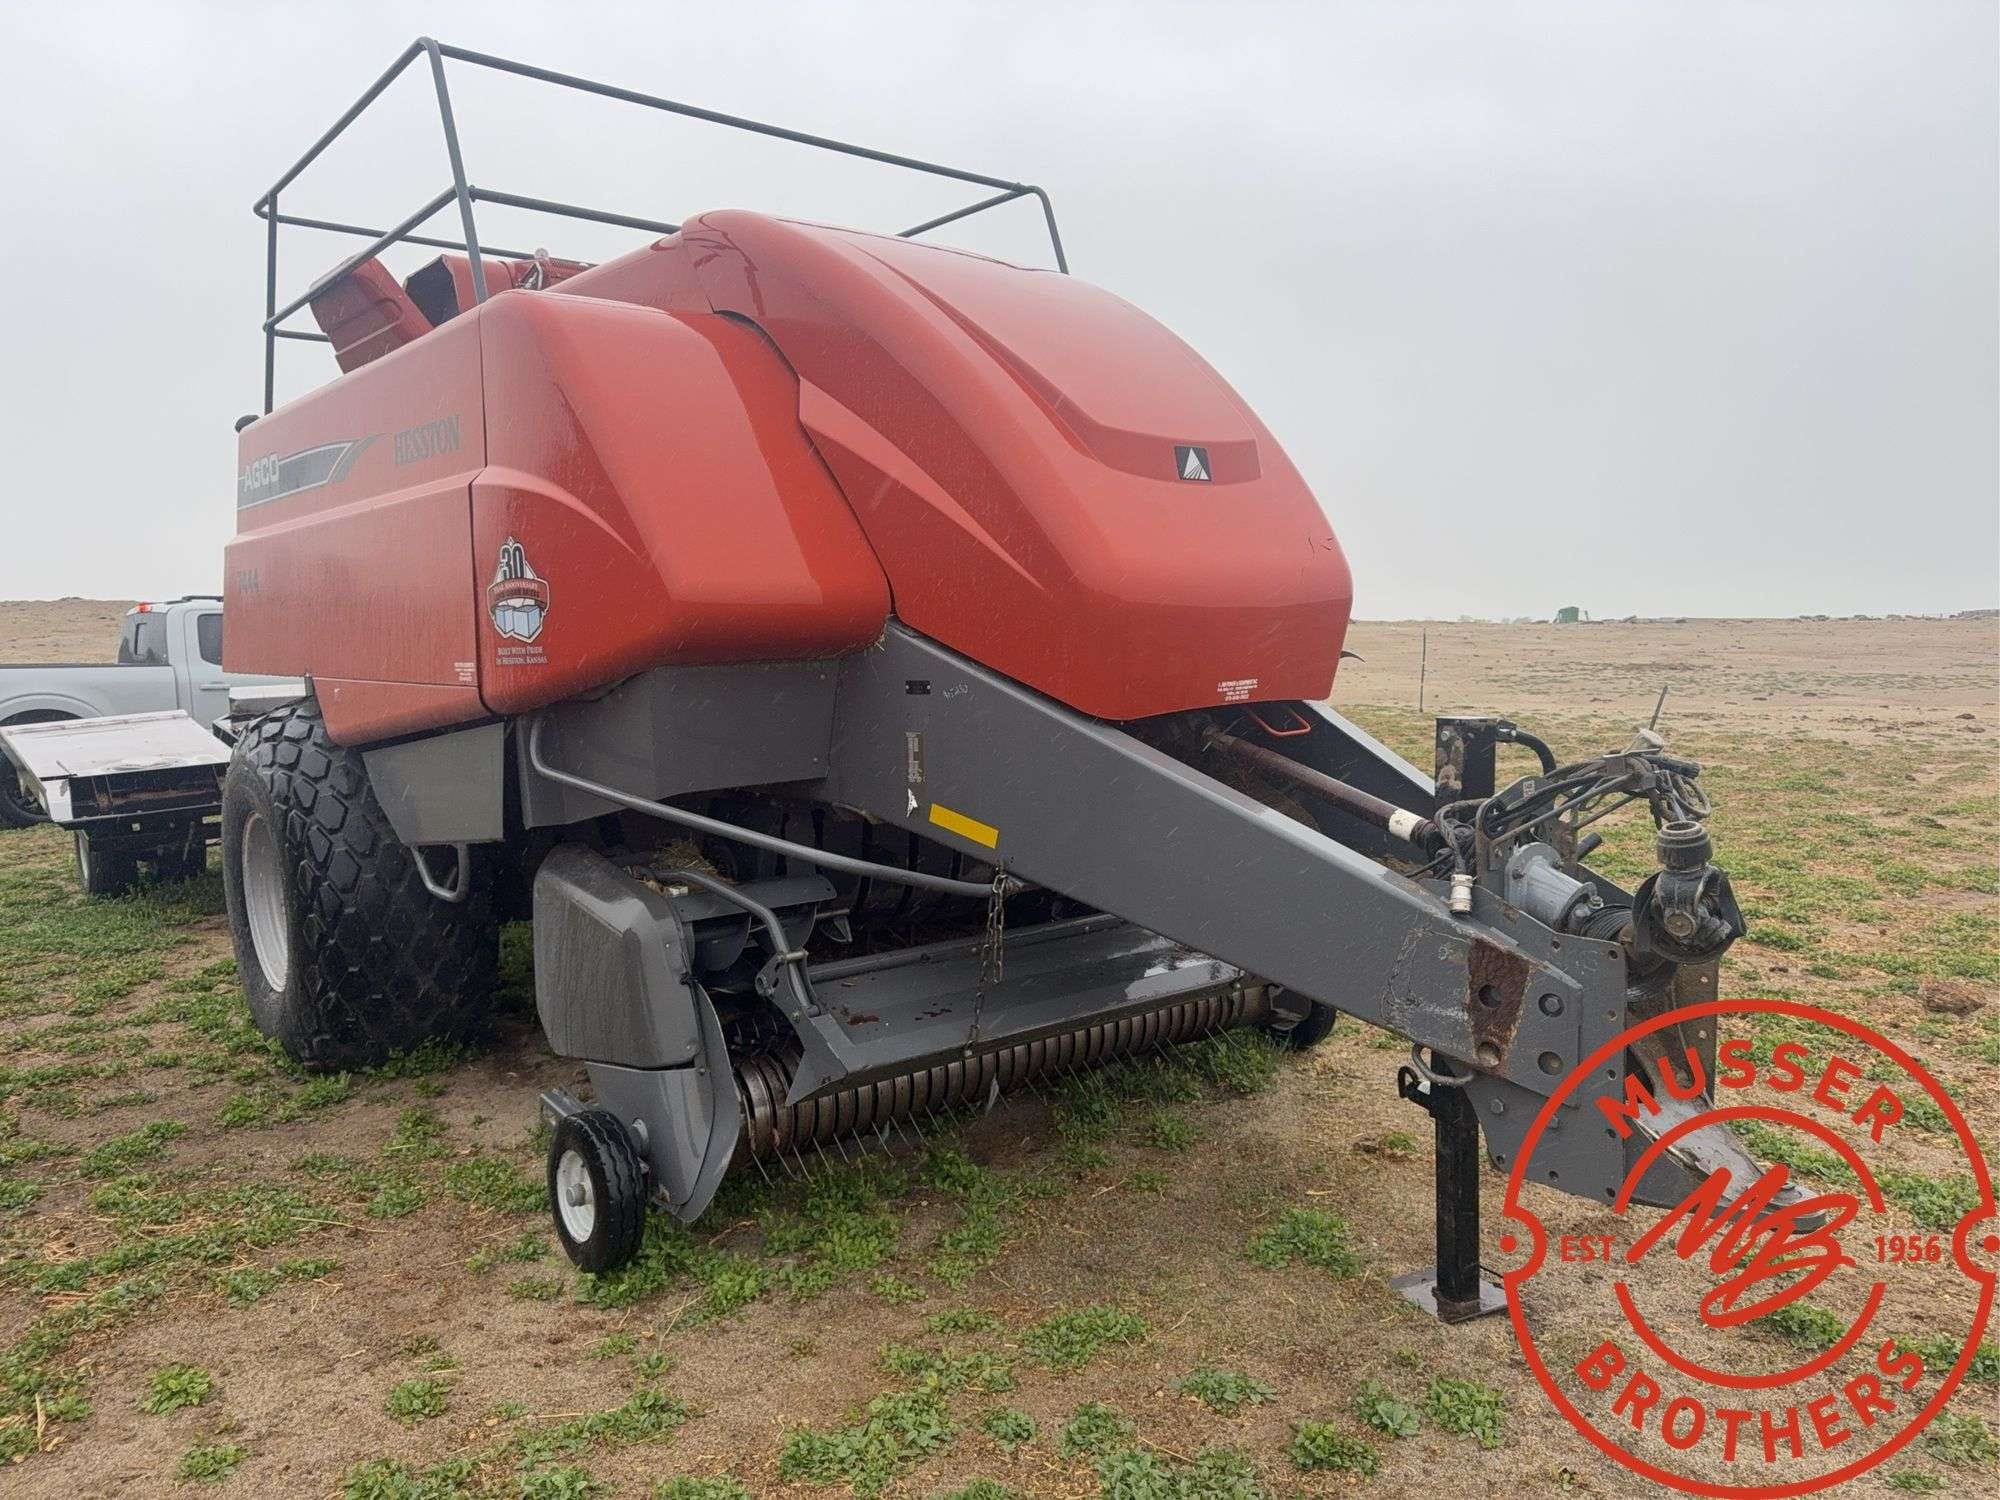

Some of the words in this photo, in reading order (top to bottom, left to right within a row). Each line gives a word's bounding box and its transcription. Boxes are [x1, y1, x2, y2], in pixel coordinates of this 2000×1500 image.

[395, 415, 460, 464] HESSTON
[243, 453, 279, 492] AGCO
[500, 545, 525, 580] 30
